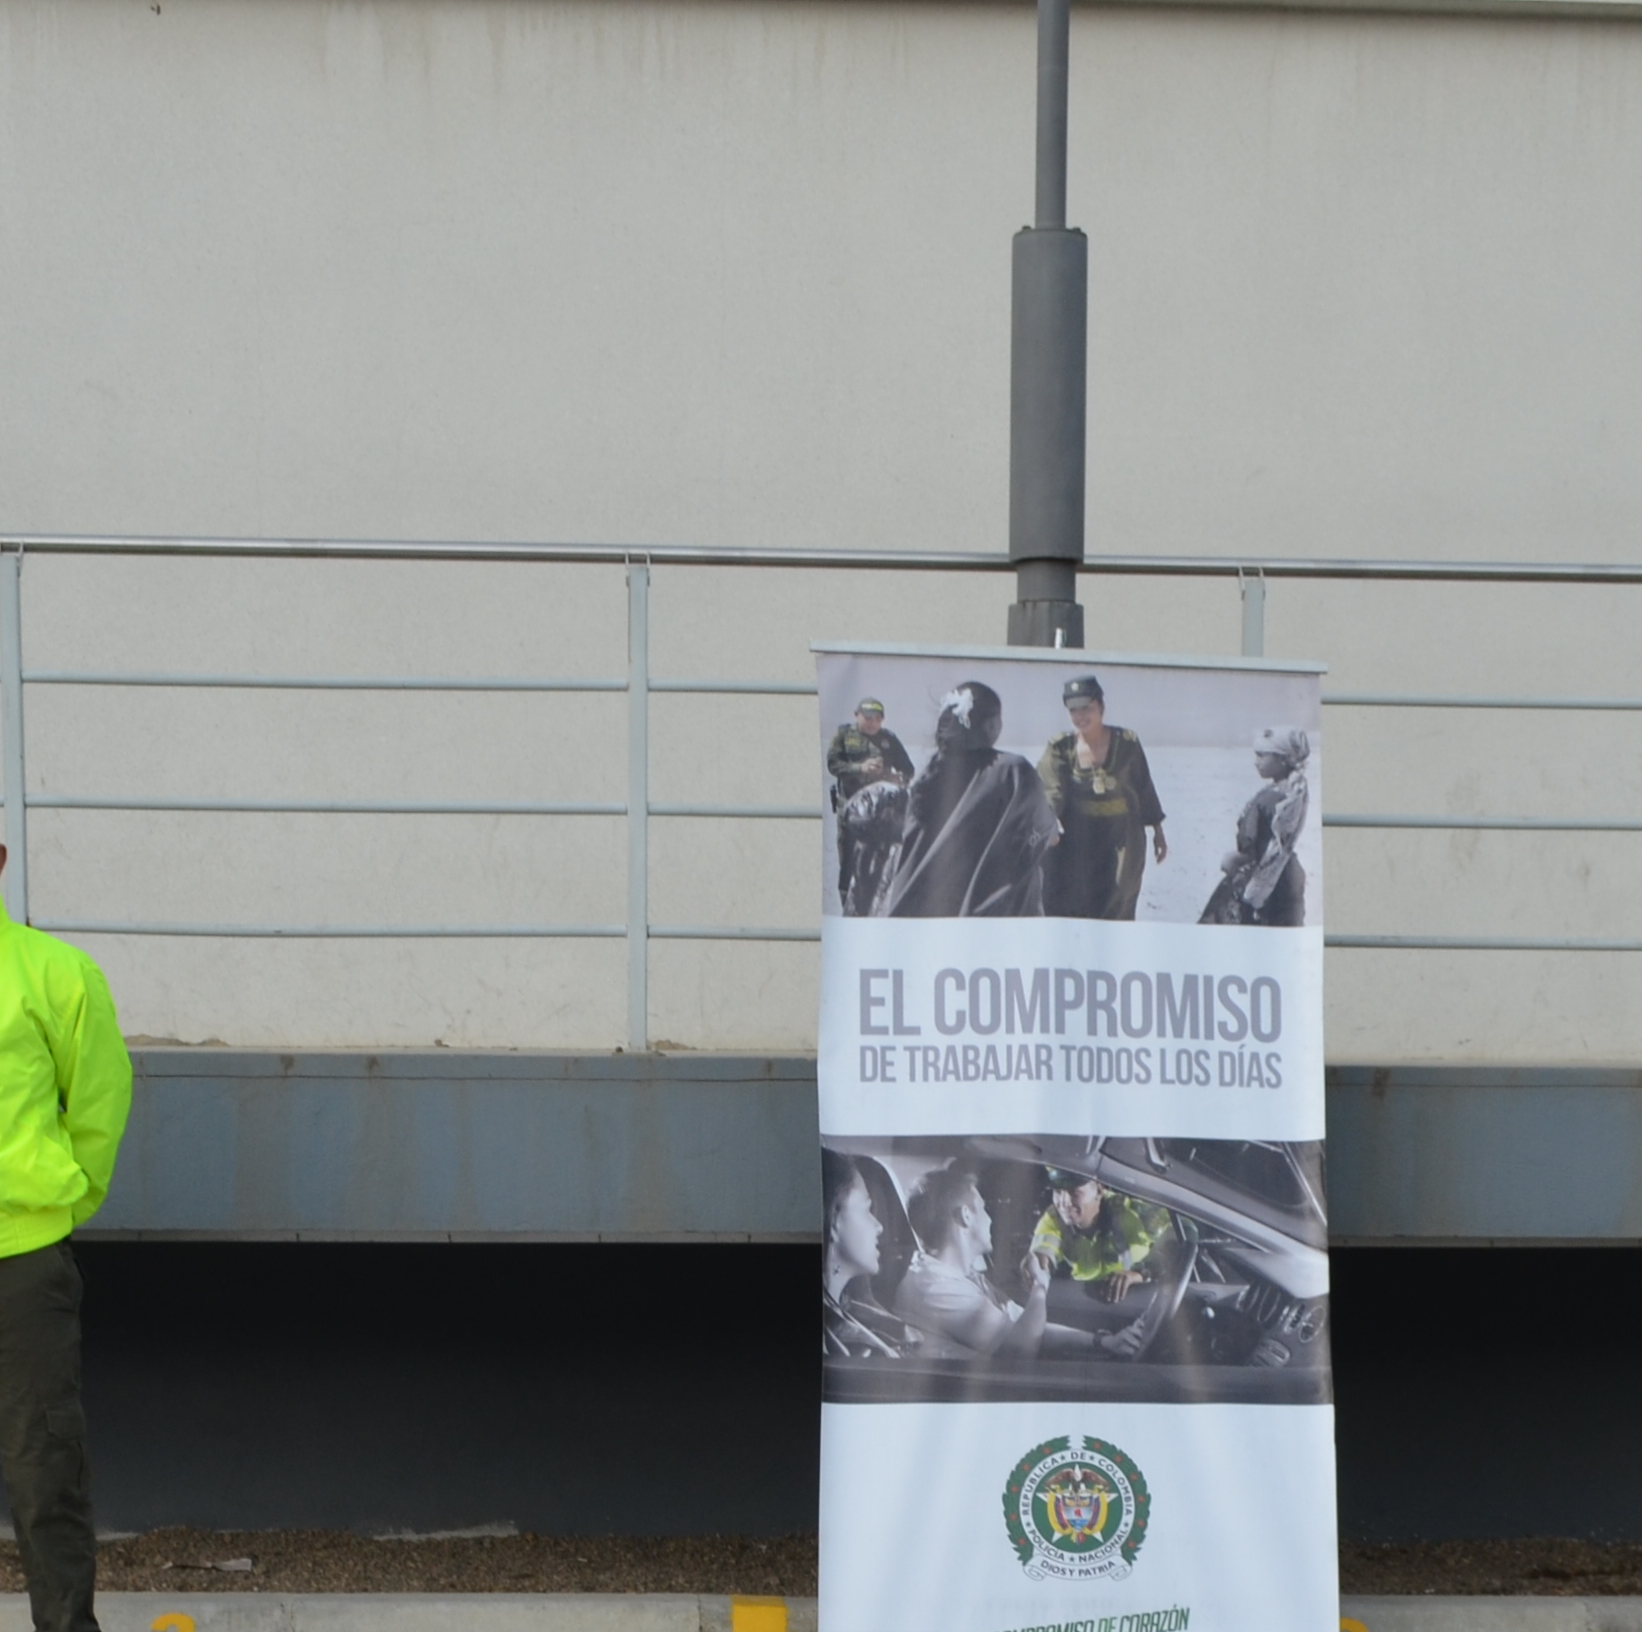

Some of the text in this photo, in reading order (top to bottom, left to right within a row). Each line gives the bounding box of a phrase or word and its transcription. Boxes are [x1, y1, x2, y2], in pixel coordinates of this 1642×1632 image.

[859, 968, 1282, 1043] EL COMPROMISO
[859, 1044, 1282, 1090] DE TRABAJAR TODOS LOS DÍAS
[1070, 1451, 1086, 1460] DE
[1098, 1458, 1132, 1516] COLOMBIA
[1040, 1560, 1066, 1576] DIOS
[1078, 1560, 1116, 1577] PATRIA
[1078, 1529, 1128, 1562] NACIONAL
